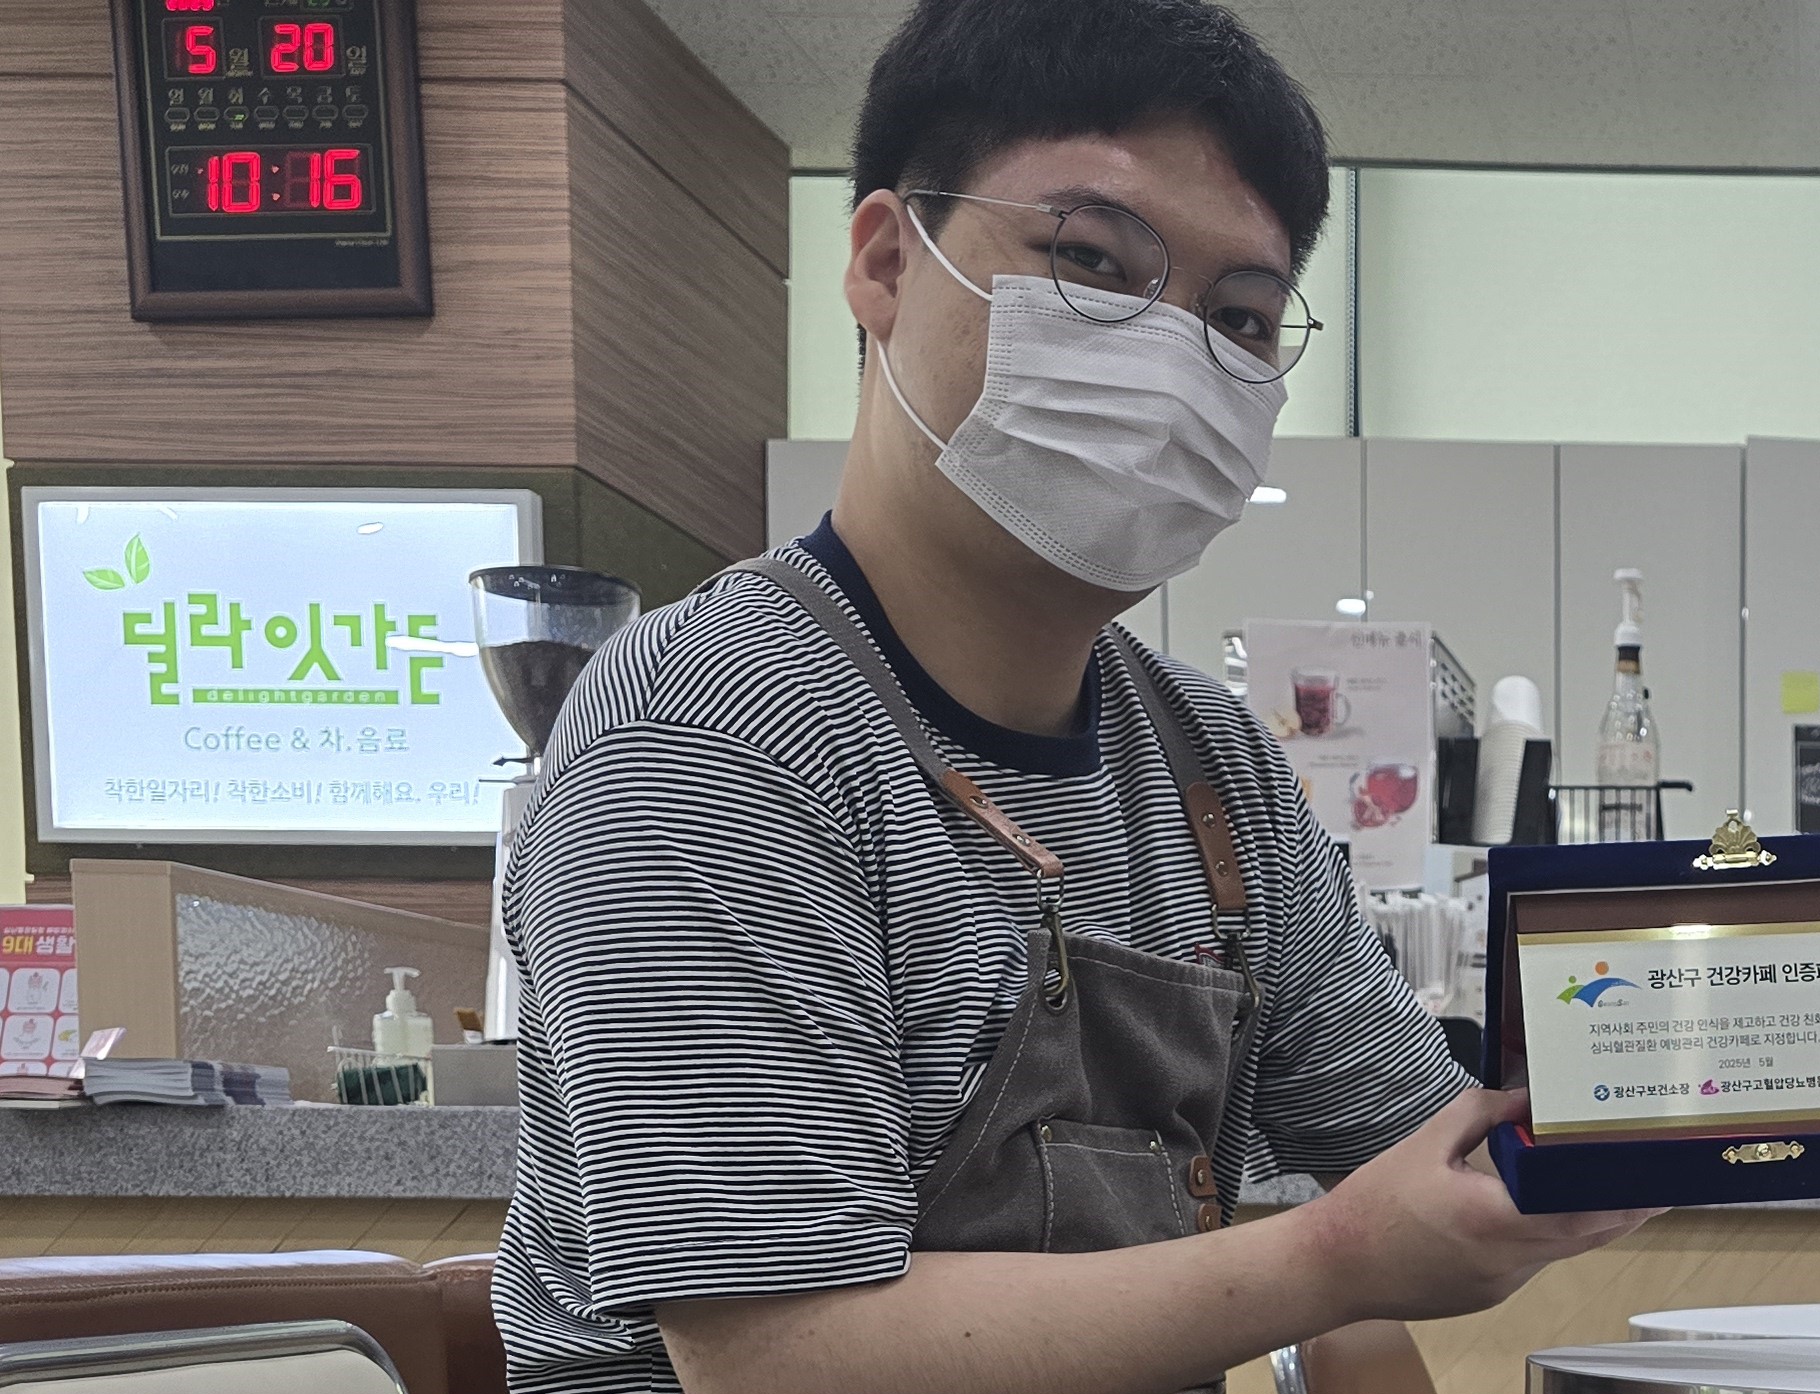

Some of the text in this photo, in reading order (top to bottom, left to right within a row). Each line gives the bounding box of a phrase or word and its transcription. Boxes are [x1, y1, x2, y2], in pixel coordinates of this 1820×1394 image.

[186, 25, 217, 75] 5
[270, 23, 334, 73] 20
[122, 592, 445, 706] 딜라잇가든
[206, 688, 388, 704] delightgarden
[184, 726, 282, 752] Coffee
[290, 728, 311, 751] &
[104, 777, 221, 805] 착한일자리!
[227, 778, 324, 805] 착한소비!
[428, 780, 481, 806] 우리!
[1647, 968, 1702, 990] 광산구
[1706, 964, 1777, 987] 건강카페
[1589, 1021, 1635, 1037] 지역사회
[1636, 1020, 1670, 1035] 주민의
[1672, 1018, 1694, 1032] 건강
[1697, 1017, 1730, 1031] 인식을
[1732, 1015, 1777, 1030] 제고하고
[1779, 1013, 1800, 1027] 건강
[1590, 1039, 1658, 1055] 심뇌혈관질환
[1660, 1036, 1704, 1051] 예방관리
[1706, 1034, 1762, 1048] 건강카페로
[1718, 1056, 1774, 1069] 2025년 5월
[1613, 1082, 1690, 1099] 광산구보건소장
